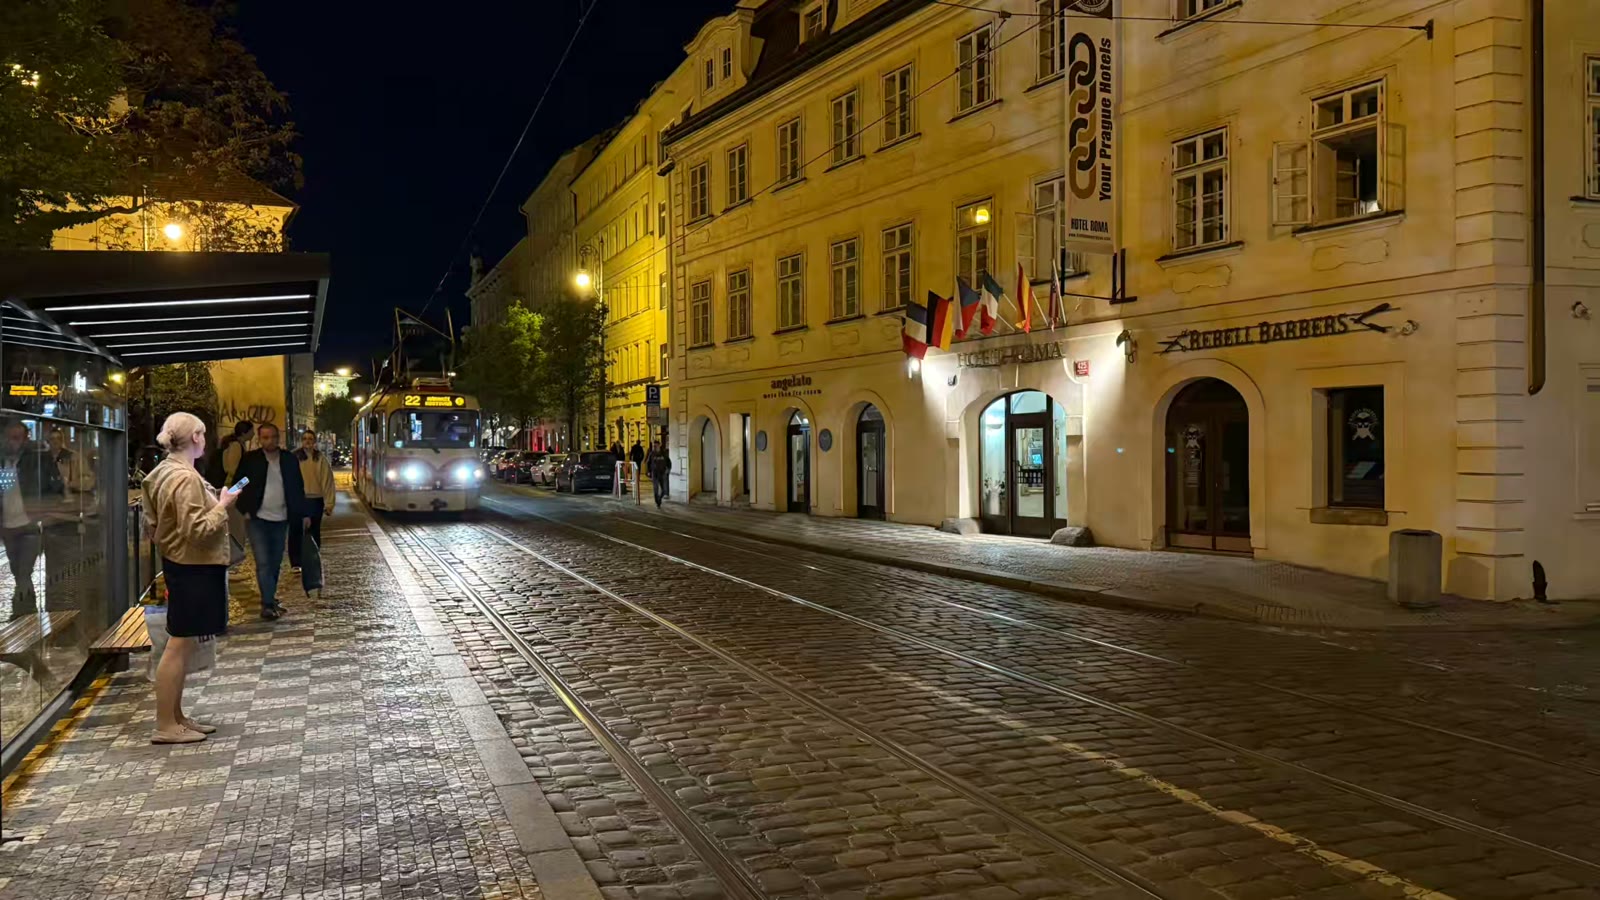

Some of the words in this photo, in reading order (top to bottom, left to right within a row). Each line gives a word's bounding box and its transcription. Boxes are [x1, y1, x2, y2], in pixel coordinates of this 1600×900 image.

[1098, 38, 1112, 95] Hotels
[1098, 97, 1114, 160] Prague
[1098, 163, 1112, 202] Your
[1071, 218, 1089, 231] HOTEL
[1090, 220, 1109, 233] ROMA
[404, 395, 421, 406] 22
[648, 387, 658, 399] P
